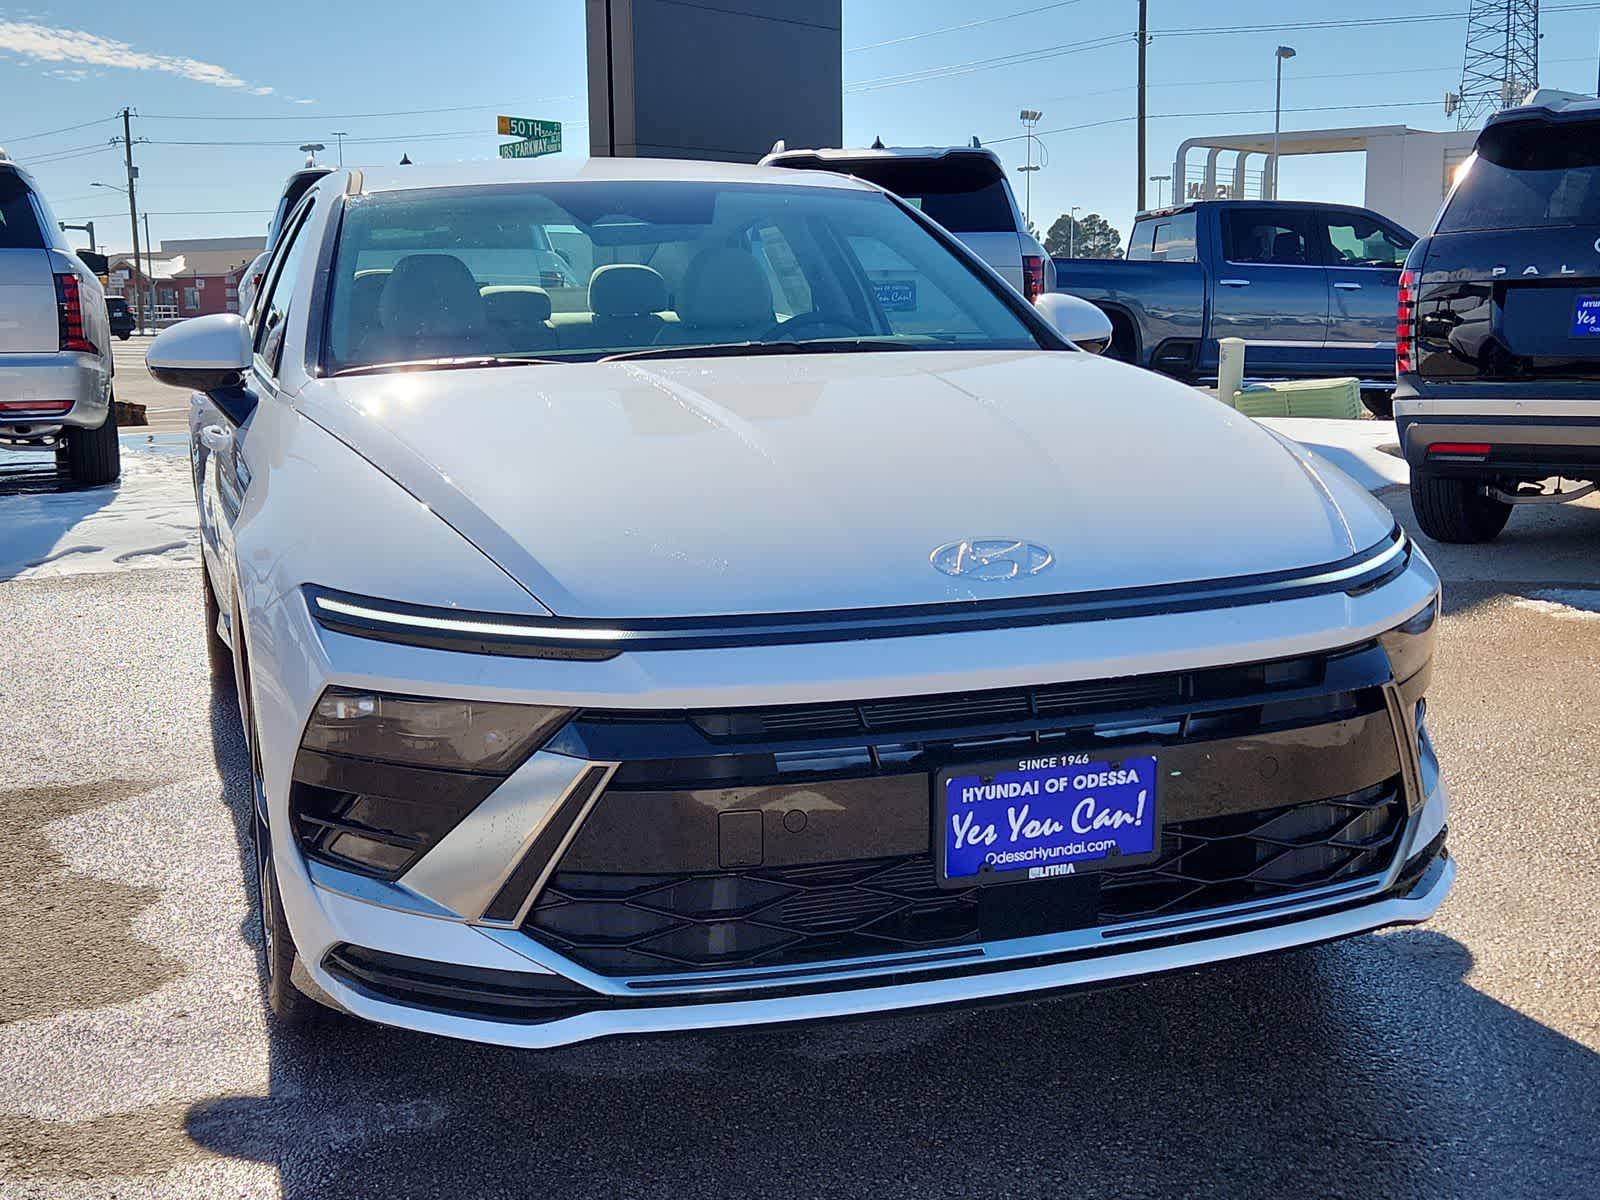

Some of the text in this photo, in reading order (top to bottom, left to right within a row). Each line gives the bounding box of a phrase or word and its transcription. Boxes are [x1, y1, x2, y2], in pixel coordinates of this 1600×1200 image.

[515, 138, 547, 157] PARKWAY
[1492, 264, 1576, 277] PAL
[1577, 310, 1597, 325] Yes
[1018, 753, 1089, 771] SINCE 1946
[962, 769, 1139, 803] HYUNDAI OF ODESSA
[952, 789, 1147, 849] Yes You Can!
[985, 839, 1116, 865] OdessaHyundai.com
[1040, 863, 1075, 878] LITHIA
